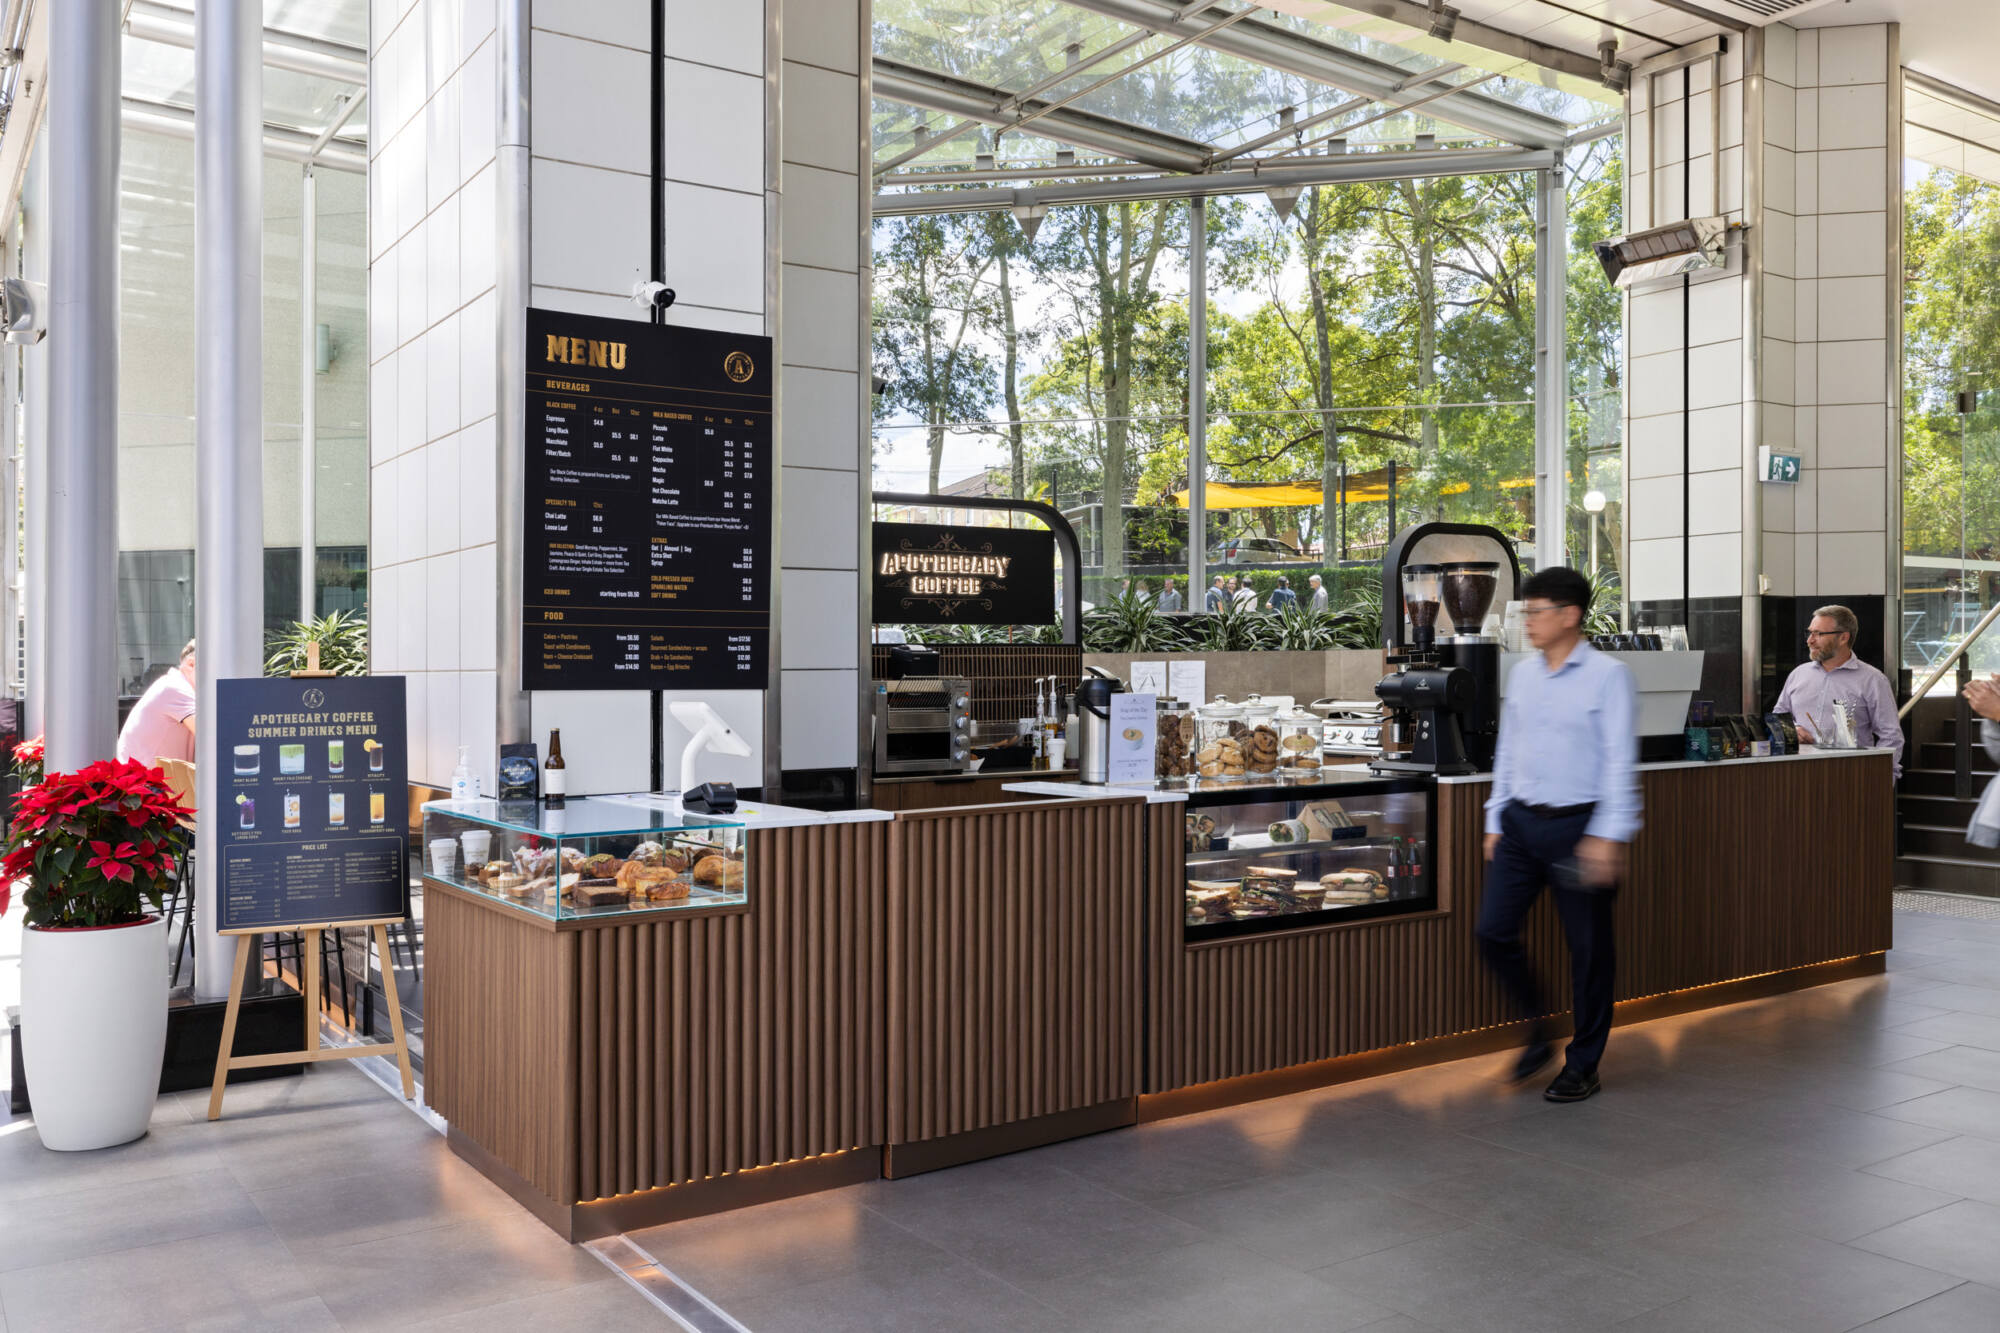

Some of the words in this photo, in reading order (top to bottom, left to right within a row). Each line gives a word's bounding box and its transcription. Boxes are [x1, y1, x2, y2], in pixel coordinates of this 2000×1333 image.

[546, 334, 627, 370] MENU
[546, 379, 590, 392] BEVERAGES
[546, 401, 560, 409] BLACK
[560, 402, 576, 410] COFFEE
[546, 414, 565, 423] Espresso
[546, 426, 557, 434] Long
[546, 449, 571, 457] Filter/Batch
[880, 552, 1011, 578] APOTHECARY
[911, 576, 982, 595] COFFEE
[544, 612, 564, 620] FOOD
[252, 712, 329, 726] APOTHECARY
[332, 712, 374, 722] COFFEE
[248, 726, 297, 738] SUMMER
[300, 726, 343, 736] DRINKS
[346, 725, 377, 735] MENU
